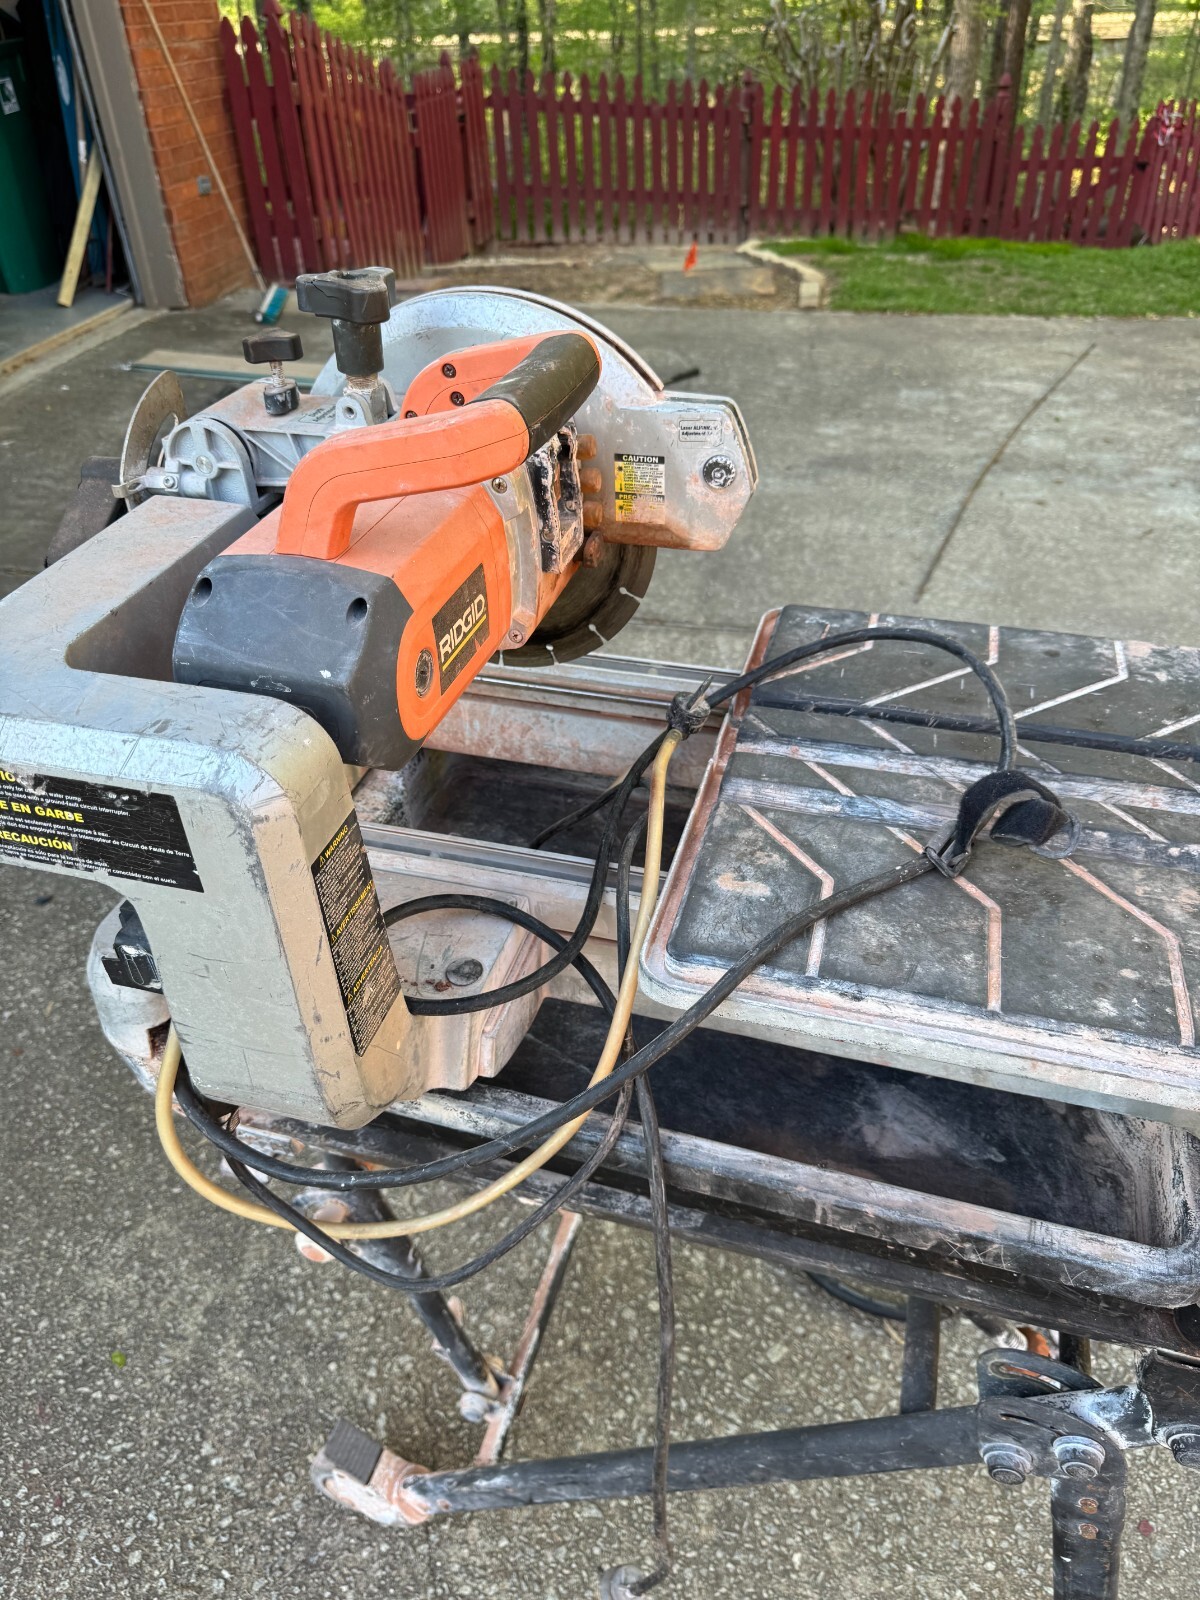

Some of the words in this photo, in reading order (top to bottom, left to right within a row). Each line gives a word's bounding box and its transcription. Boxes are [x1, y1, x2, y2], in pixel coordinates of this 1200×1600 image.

[622, 454, 659, 463] CAUTION
[438, 593, 486, 663] RIDGID
[11, 801, 31, 814] EN
[120, 841, 140, 849] Circuit
[324, 825, 349, 858] WARNING
[336, 880, 374, 937] AVERTISSEMENT
[352, 944, 383, 993] ADVERTENCIA
